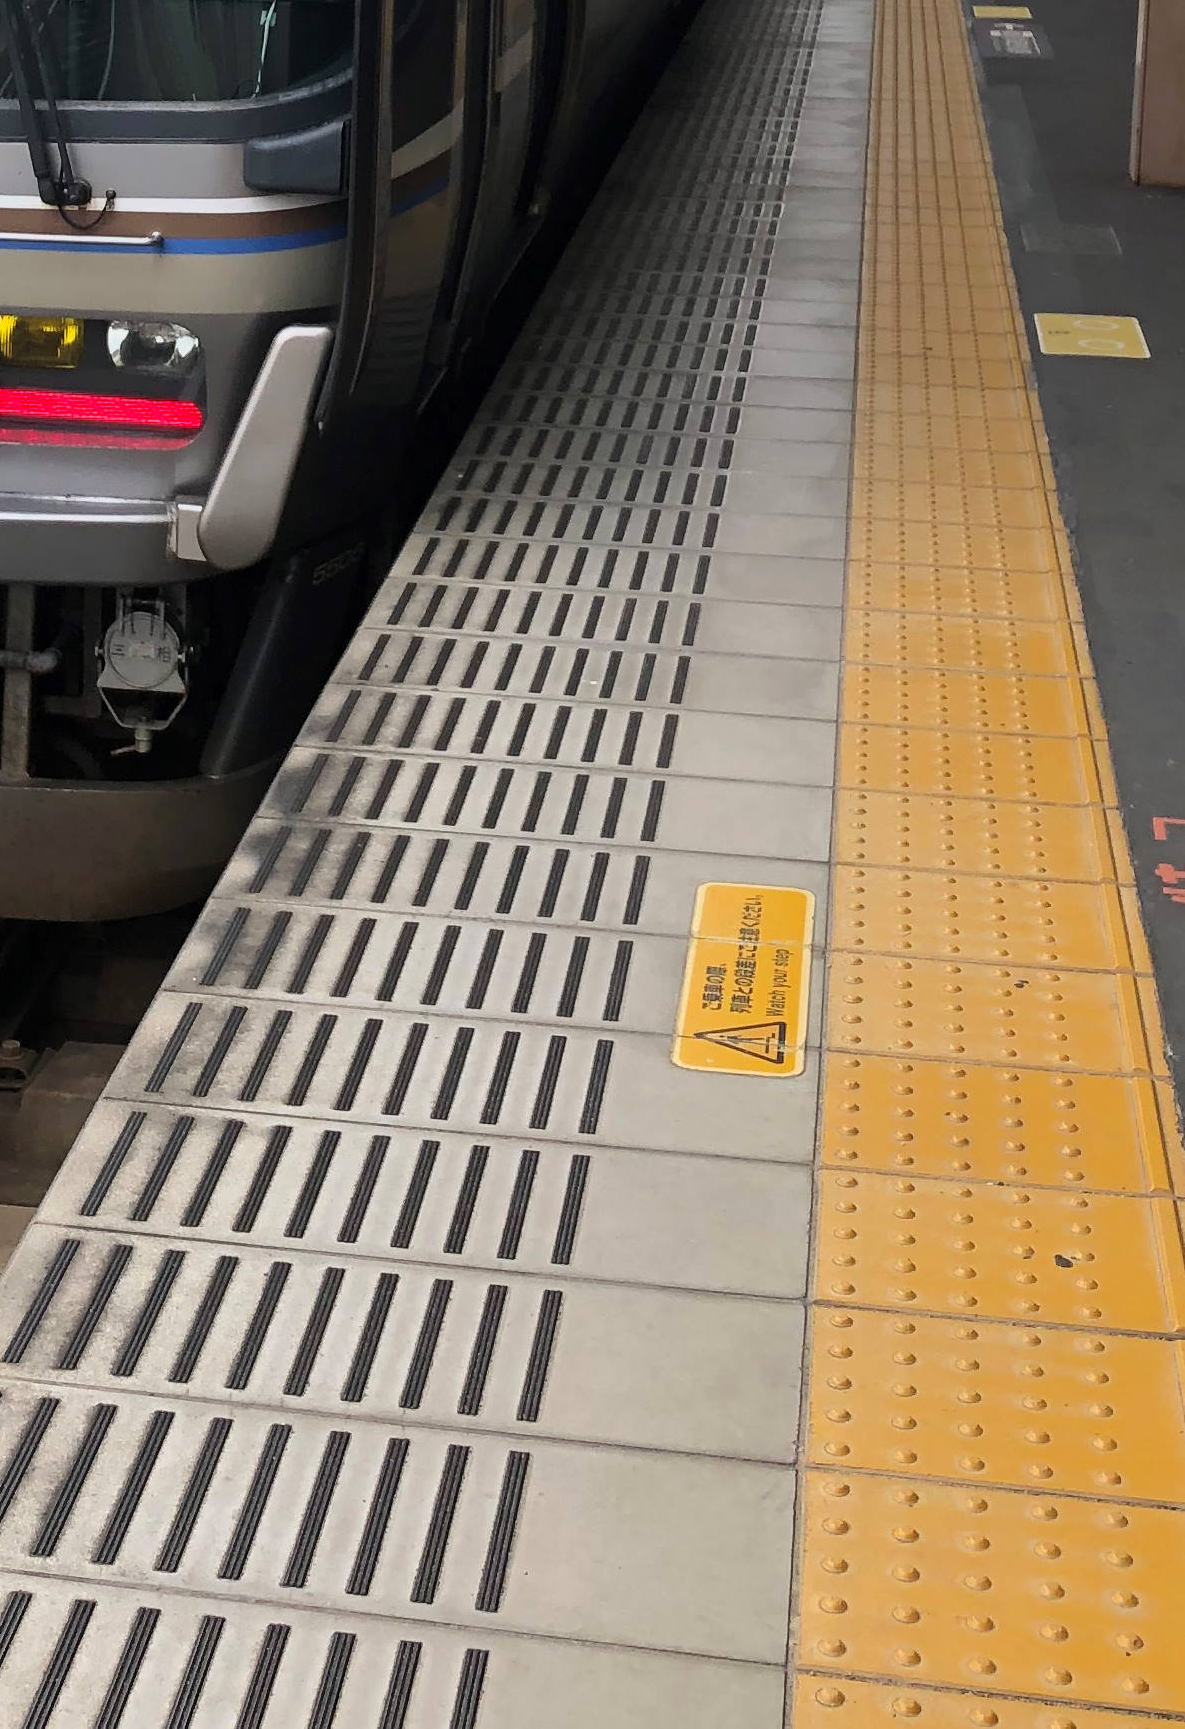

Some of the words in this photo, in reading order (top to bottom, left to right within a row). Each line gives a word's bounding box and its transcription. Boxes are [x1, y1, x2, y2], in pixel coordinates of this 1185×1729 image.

[770, 948, 793, 967] step
[769, 968, 791, 989] your
[766, 989, 786, 1017] Watch
